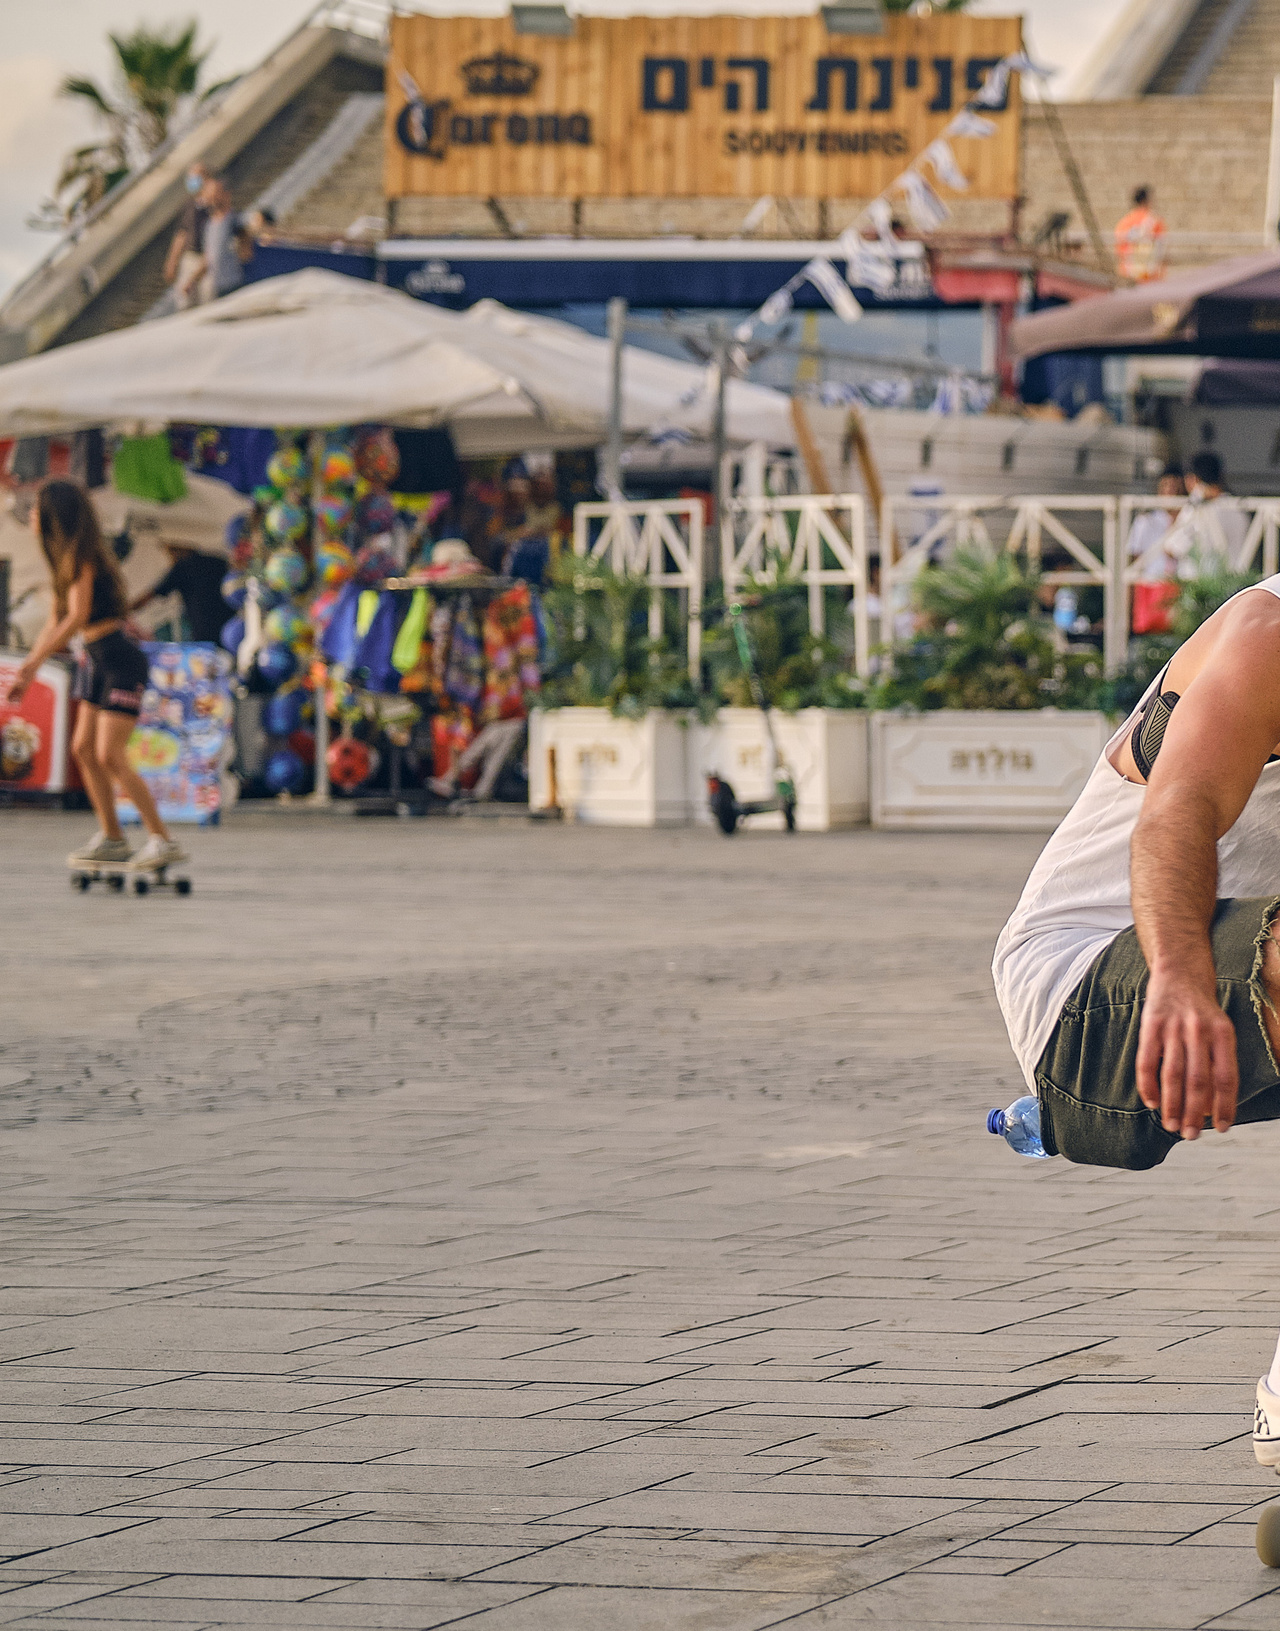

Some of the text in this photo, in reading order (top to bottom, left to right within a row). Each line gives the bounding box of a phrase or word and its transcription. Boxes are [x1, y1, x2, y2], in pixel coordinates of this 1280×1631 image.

[643, 57, 1010, 112] פנינת הים
[396, 100, 588, 160] Corona
